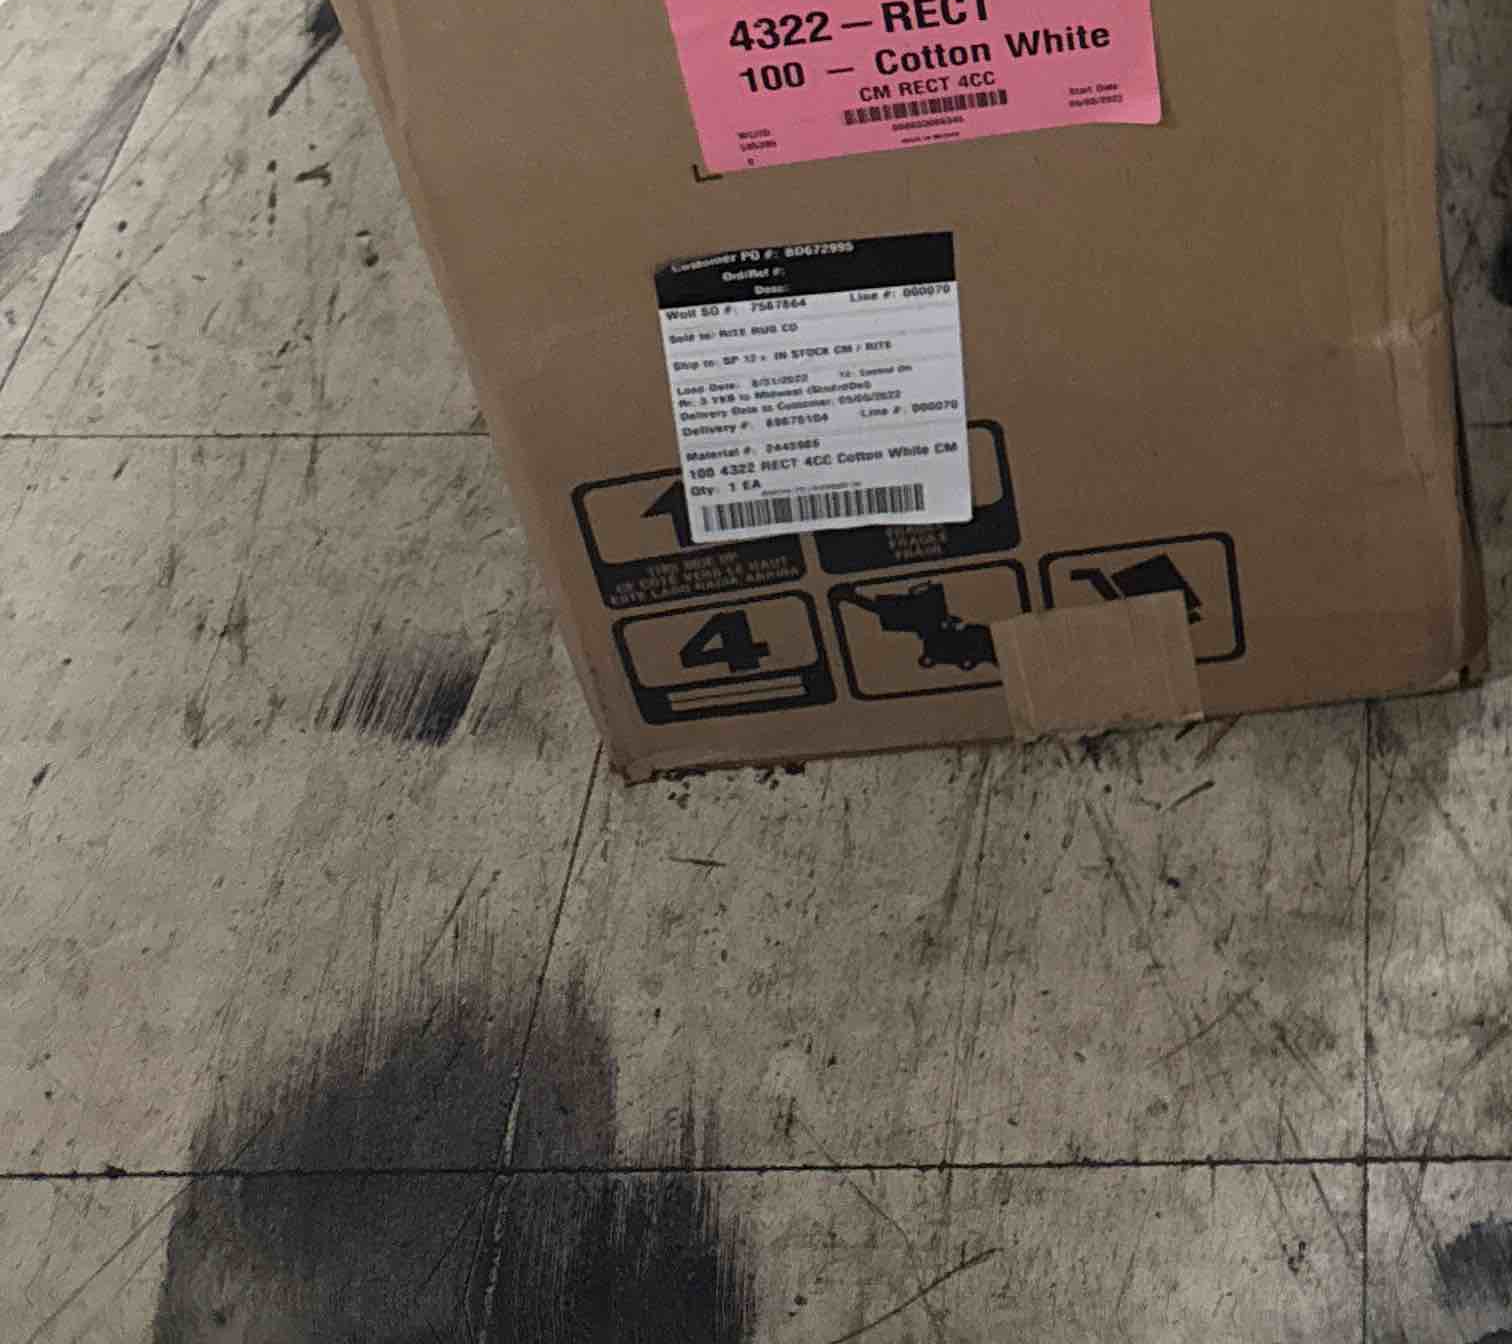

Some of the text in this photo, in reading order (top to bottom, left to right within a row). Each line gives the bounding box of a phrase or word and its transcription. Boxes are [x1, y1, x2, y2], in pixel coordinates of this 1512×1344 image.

[729, 10, 834, 51] 4322
[739, 61, 806, 93] 100
[874, 41, 992, 76] Cotton
[1004, 25, 1111, 58] White
[859, 70, 997, 103] CM RECT 4CC
[720, 461, 755, 476] 4322
[837, 450, 883, 464] Cotton
[888, 445, 930, 459] White
[934, 441, 959, 454] CM
[679, 610, 771, 673] 4
